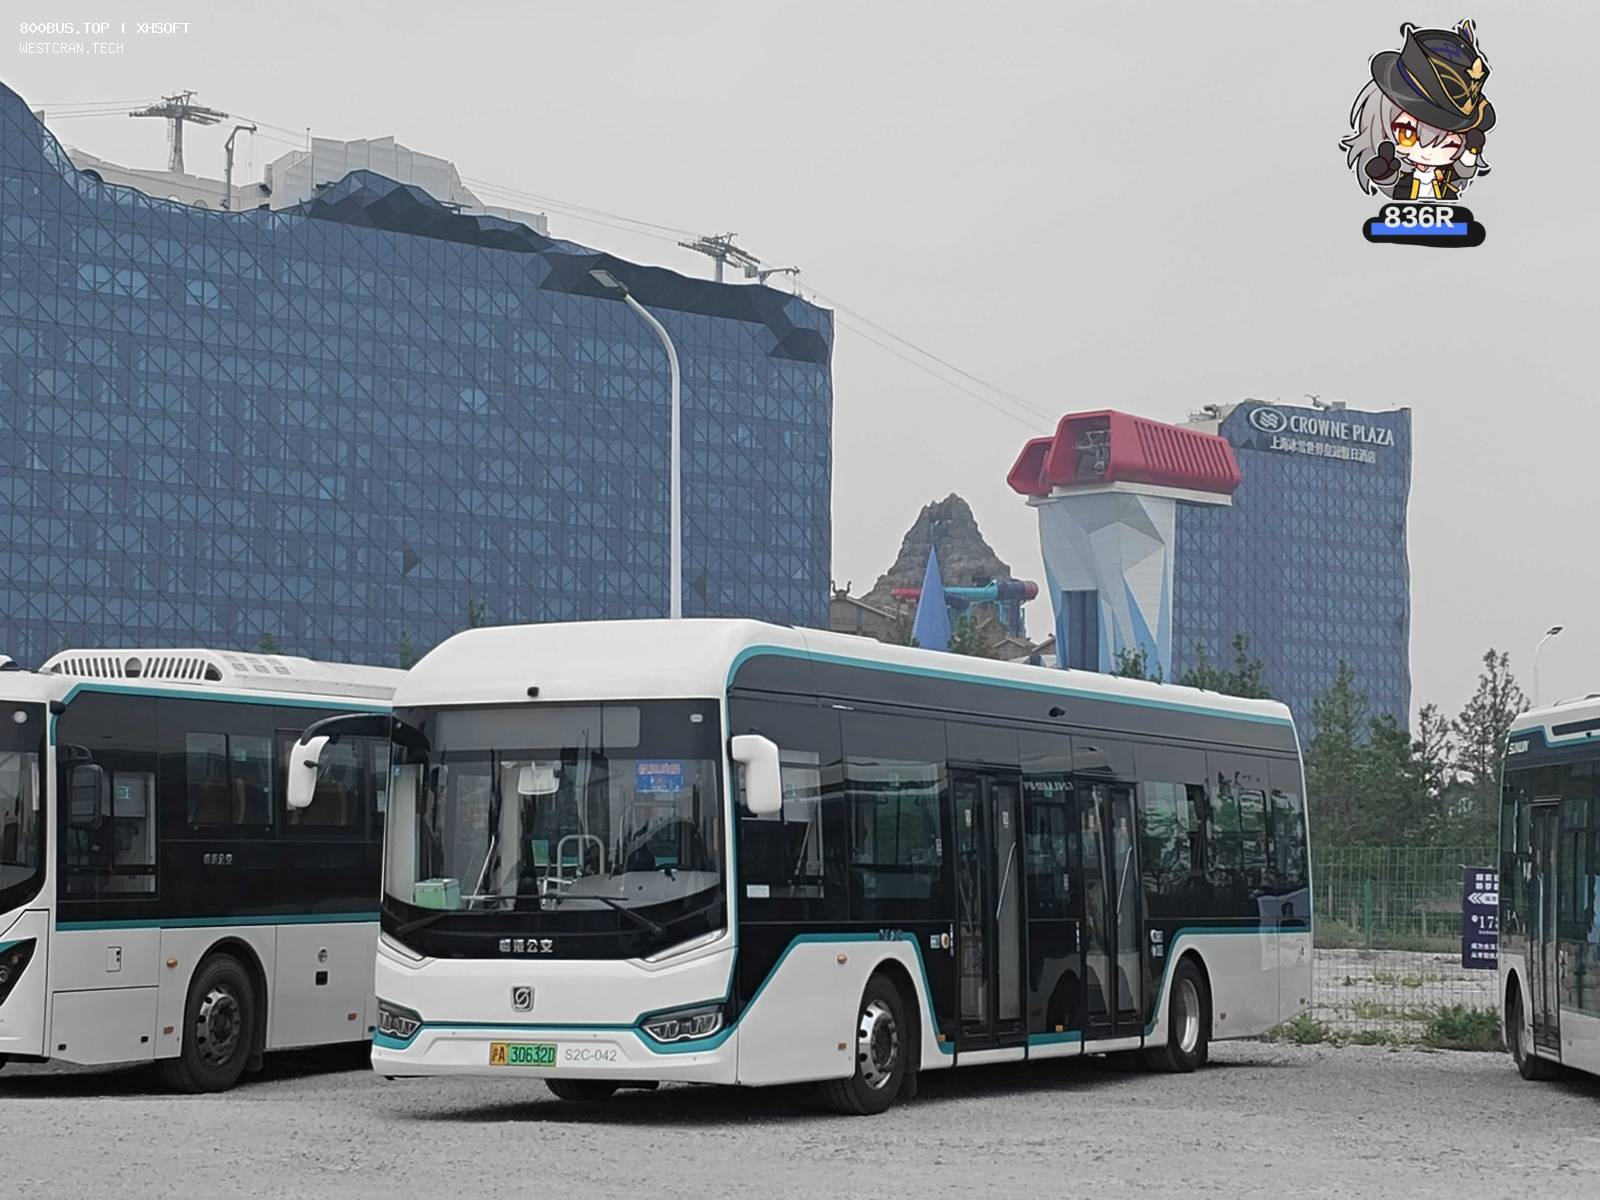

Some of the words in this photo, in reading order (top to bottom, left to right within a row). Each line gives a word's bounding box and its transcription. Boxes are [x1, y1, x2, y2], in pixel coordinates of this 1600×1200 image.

[1290, 415, 1350, 439] CROWNE
[1352, 424, 1394, 446] PLAZA
[565, 1049, 617, 1062] S2C-042
